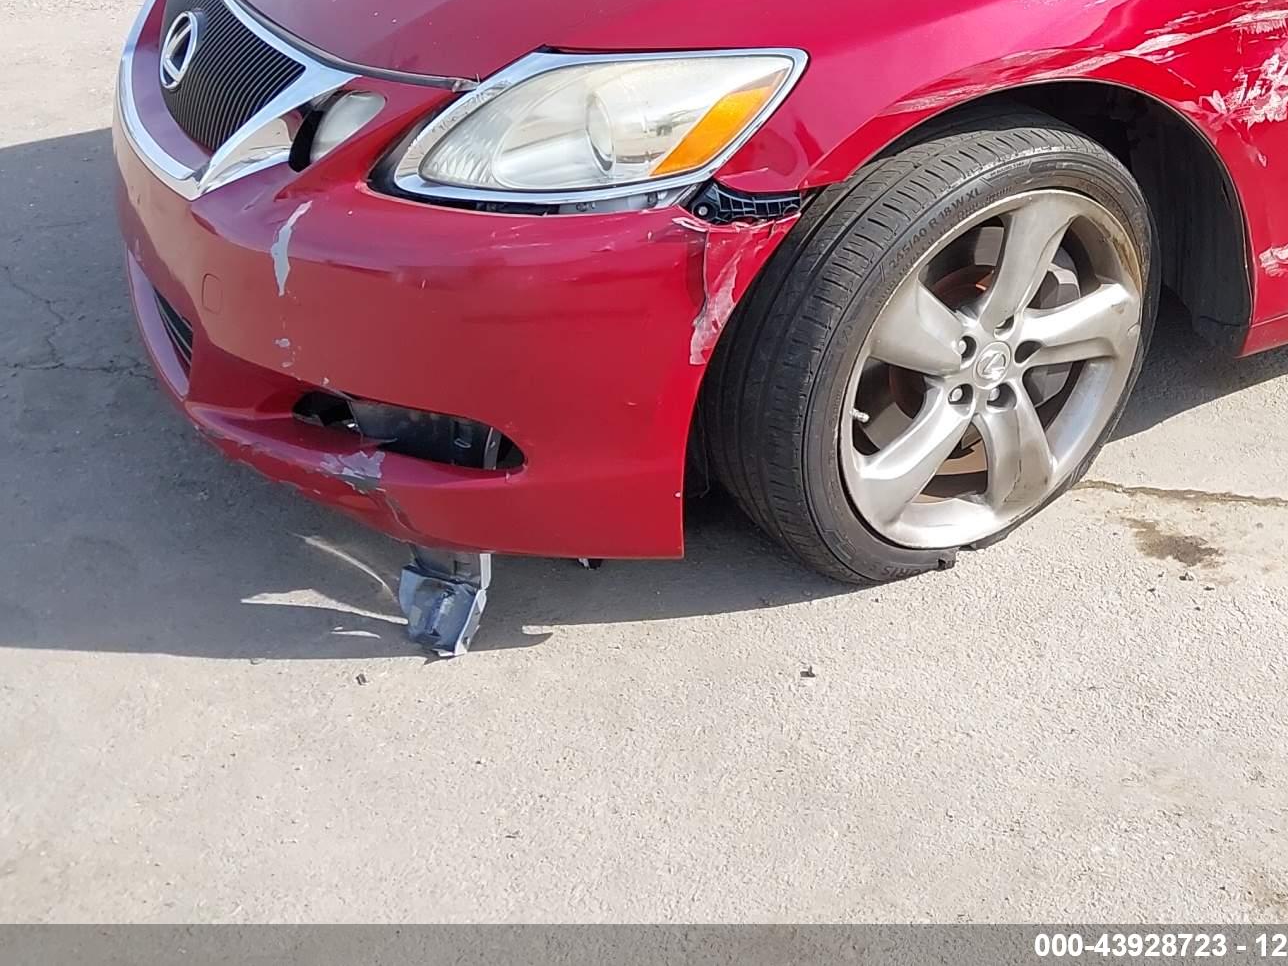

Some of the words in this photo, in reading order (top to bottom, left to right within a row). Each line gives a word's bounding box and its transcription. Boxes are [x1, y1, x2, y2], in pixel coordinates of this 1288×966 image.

[928, 217, 939, 229] R
[940, 205, 953, 219] 18
[966, 187, 982, 200] XL
